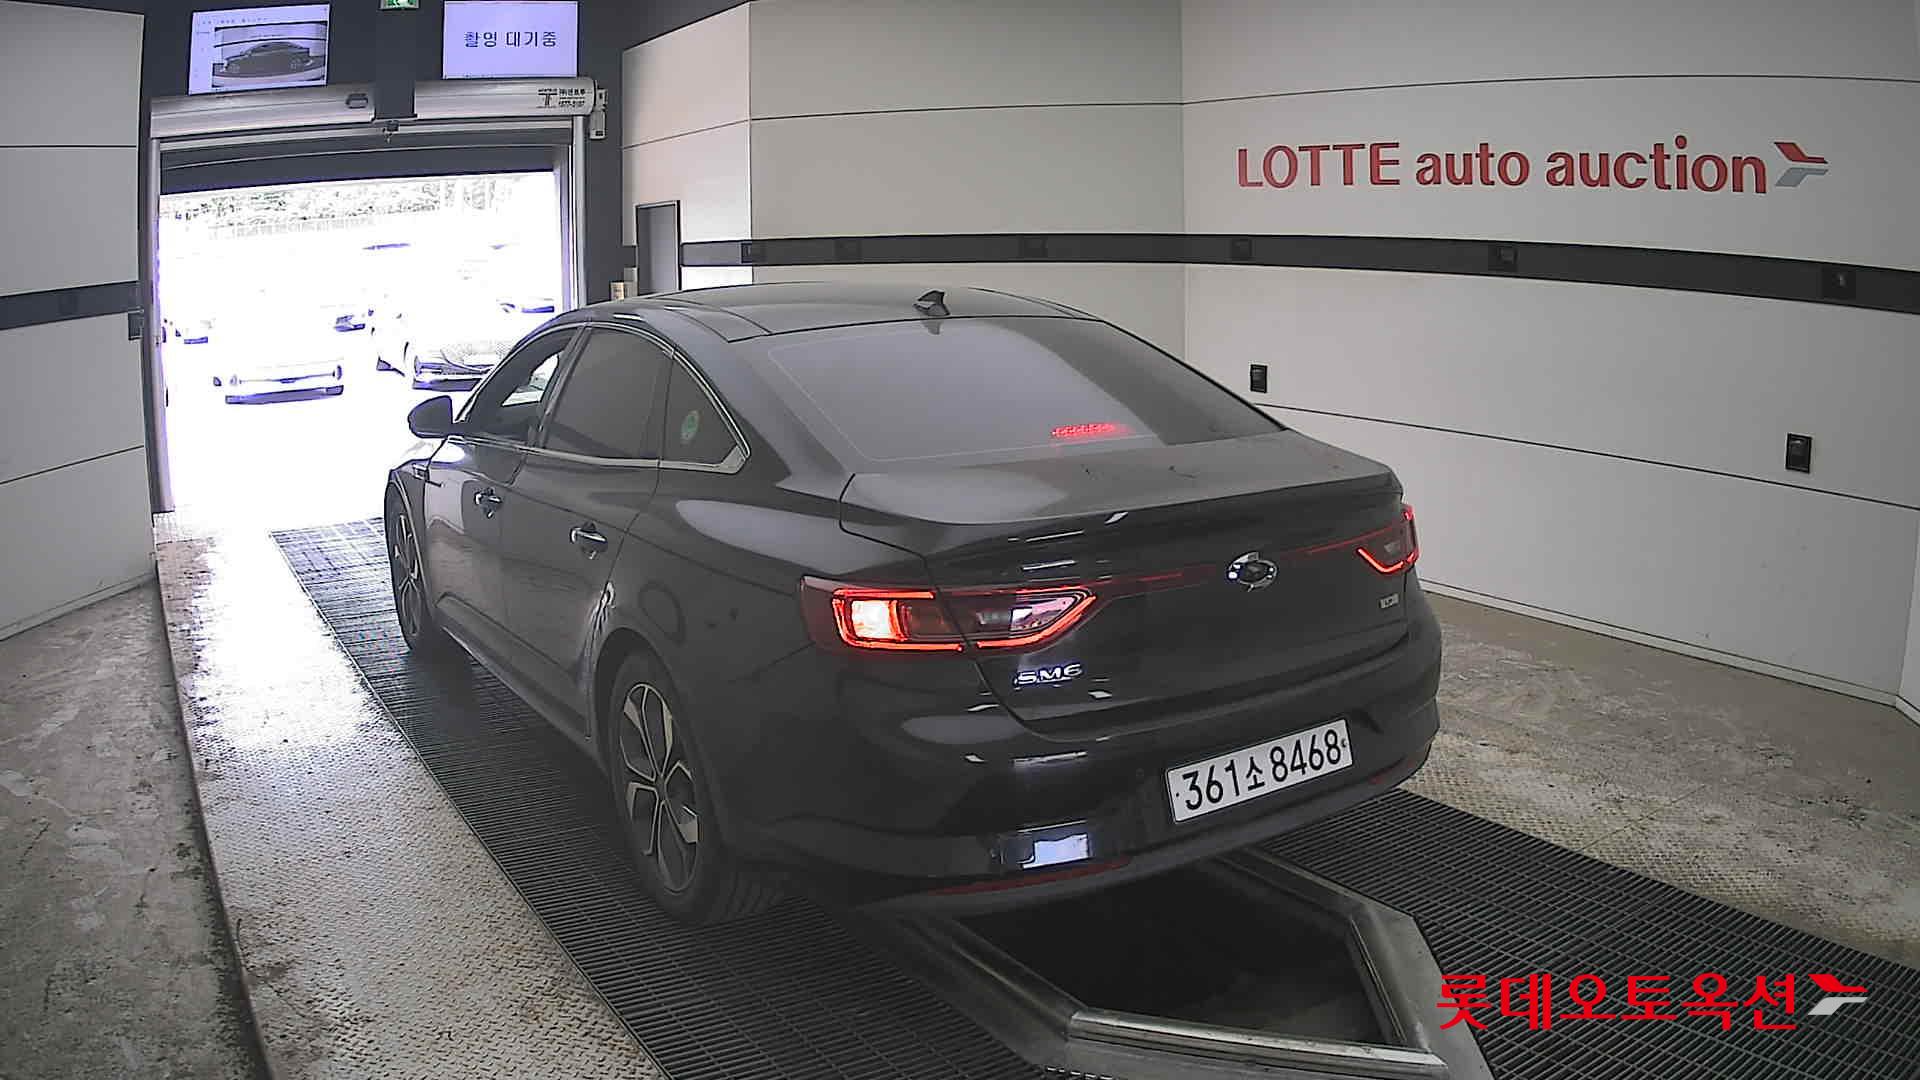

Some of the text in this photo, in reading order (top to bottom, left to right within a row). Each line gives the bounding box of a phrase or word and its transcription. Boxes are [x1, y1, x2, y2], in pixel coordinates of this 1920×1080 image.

[1237, 135, 1768, 195] LOTTE auto auction
[1017, 663, 1082, 685] SM6
[1182, 729, 1342, 811] 361소8468
